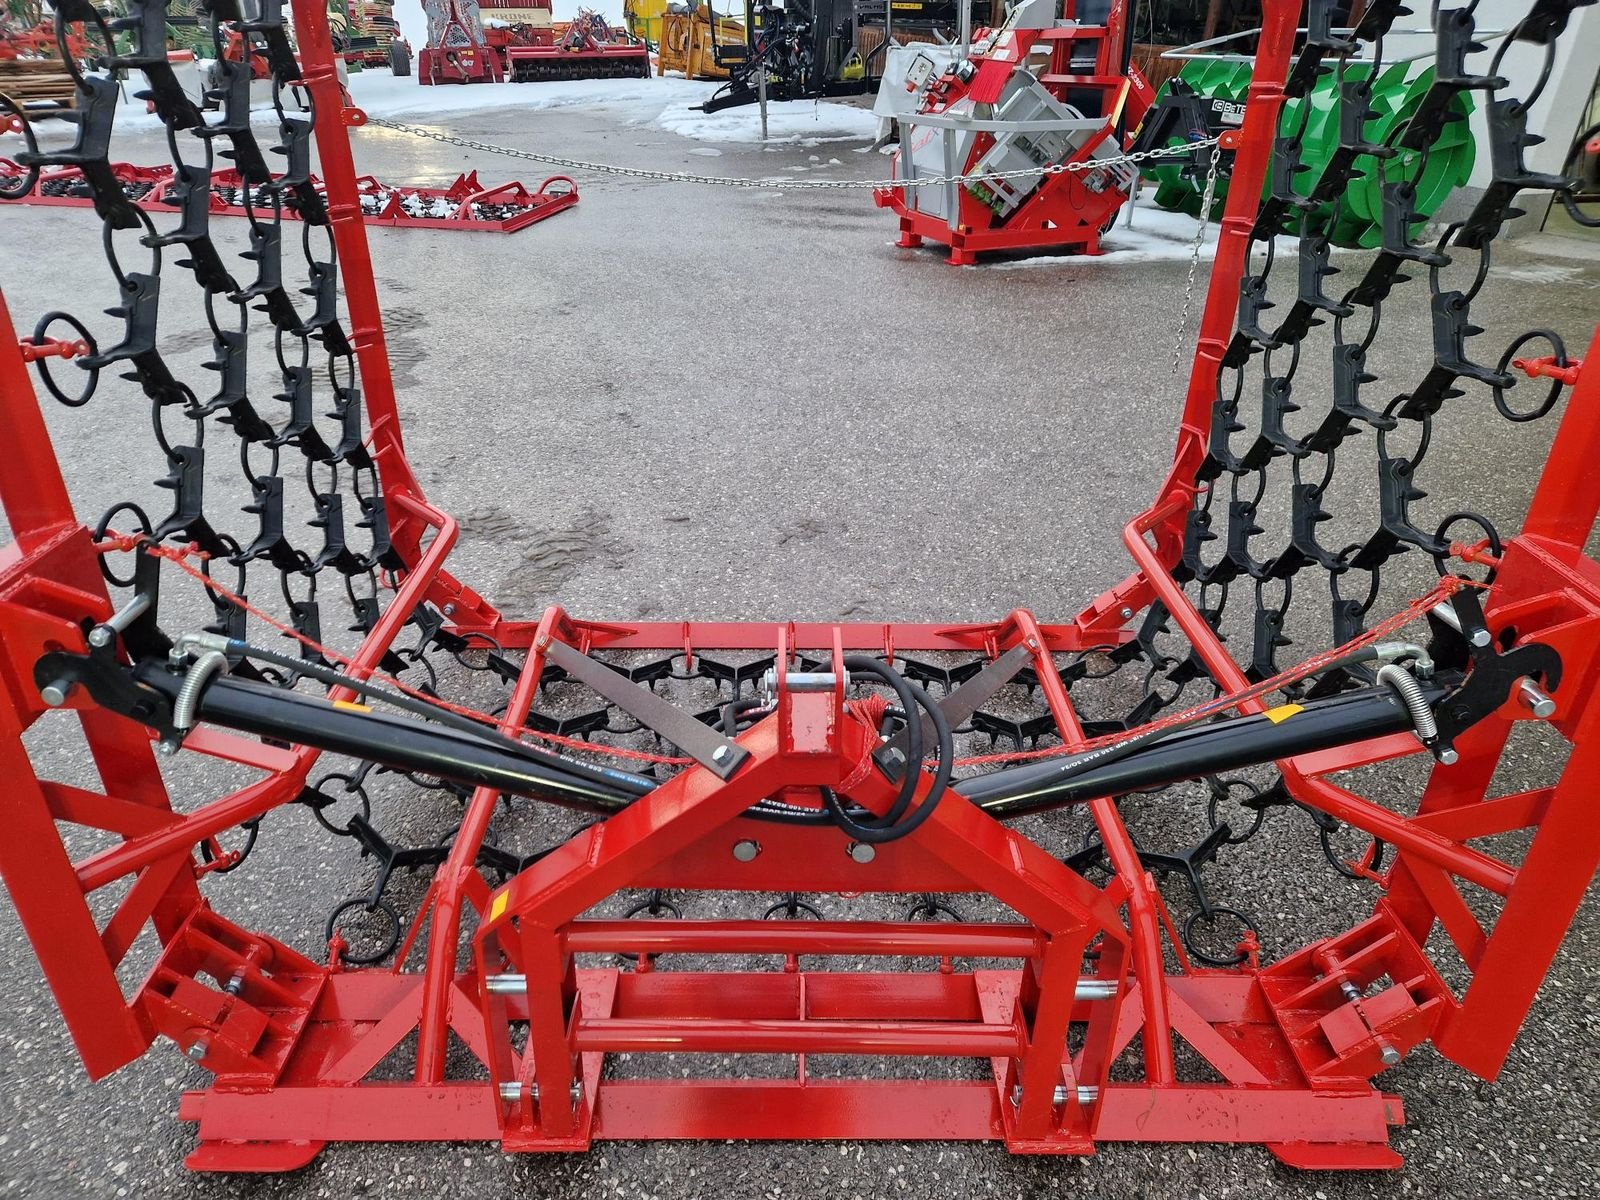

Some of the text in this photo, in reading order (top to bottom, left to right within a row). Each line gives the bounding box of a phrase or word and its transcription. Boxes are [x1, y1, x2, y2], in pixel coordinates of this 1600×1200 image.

[491, 12, 536, 20] KRONE
[1115, 740, 1129, 749] WP
[559, 754, 574, 764] DIN
[1083, 751, 1101, 763] BAR
